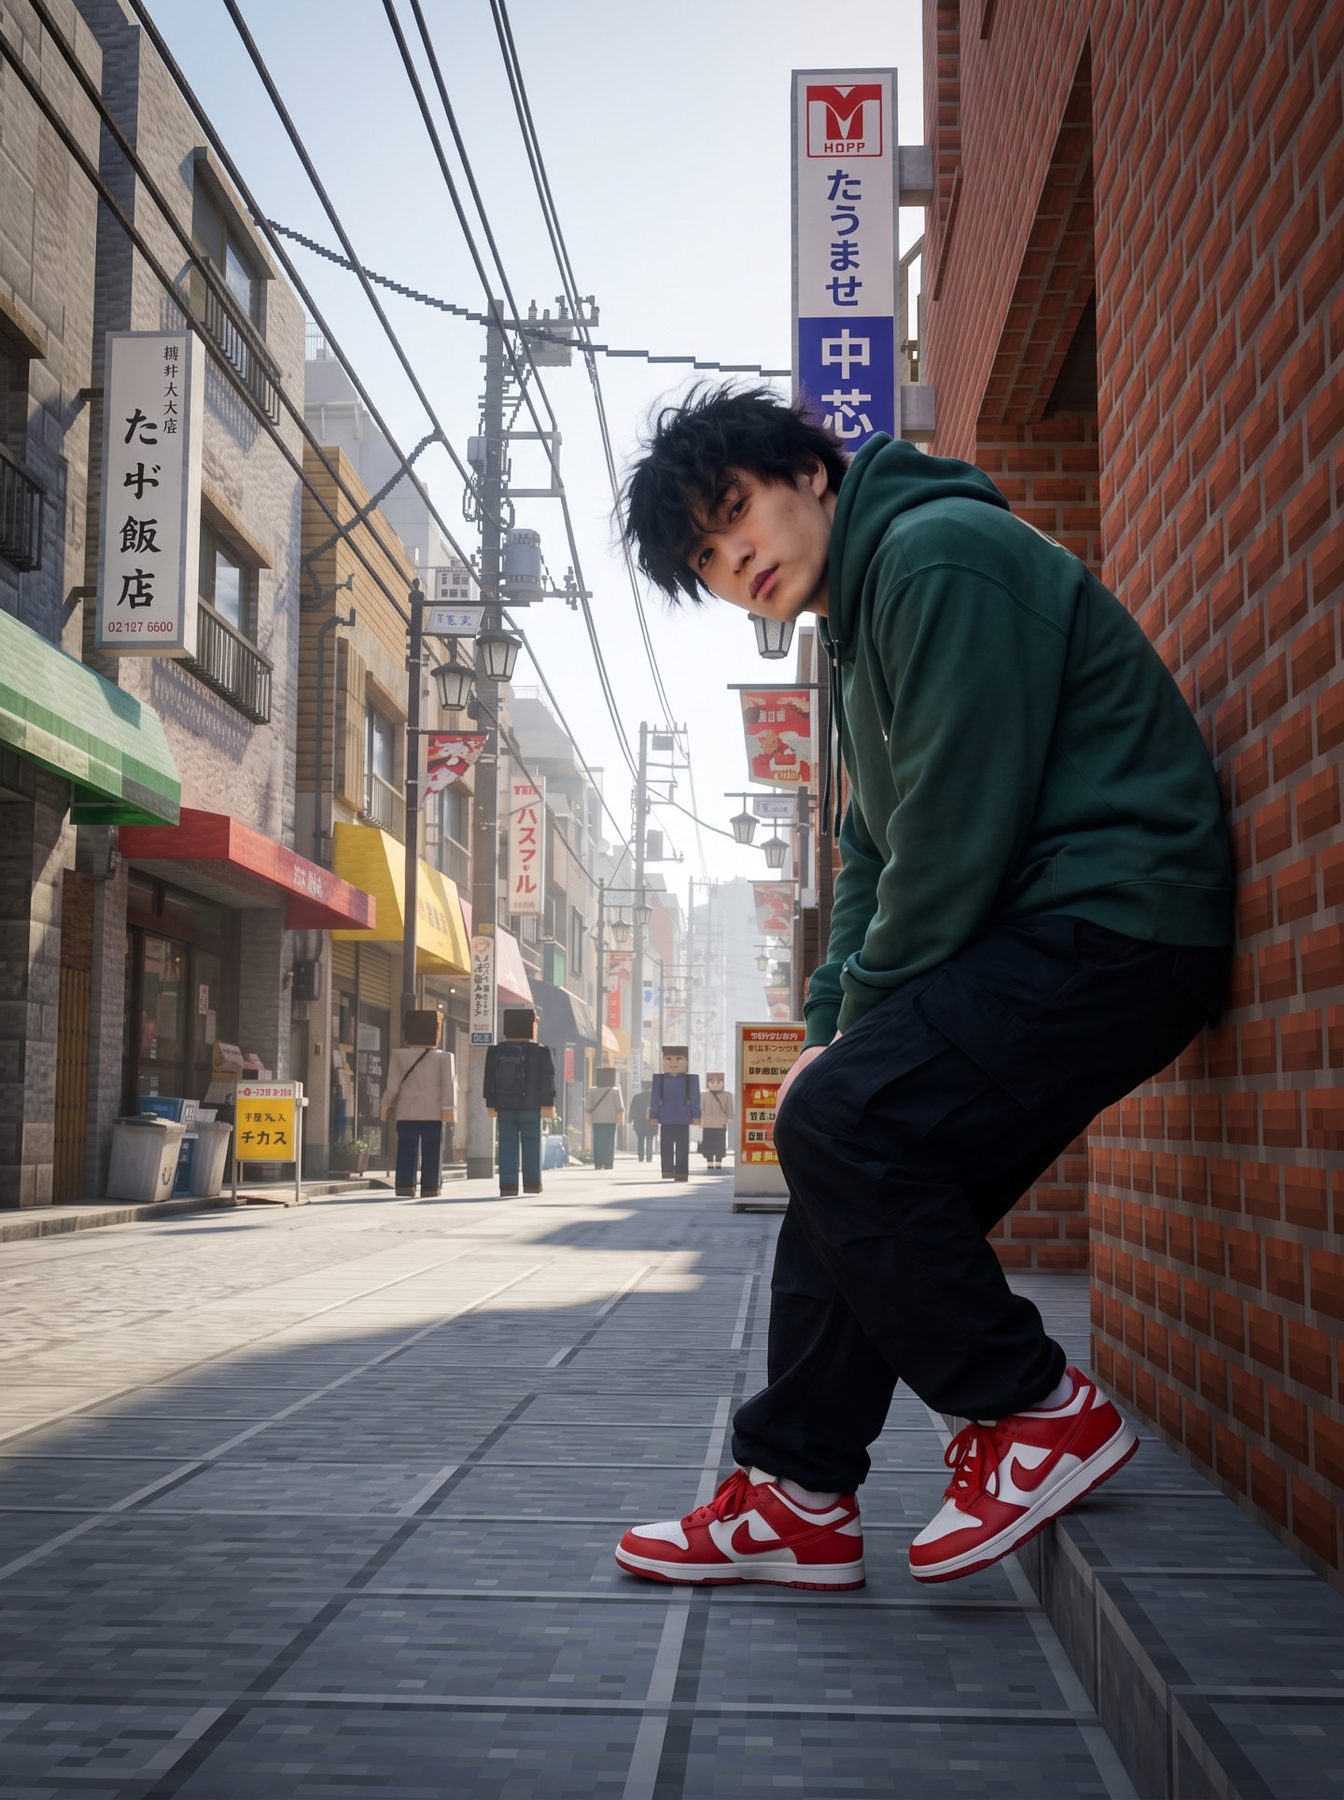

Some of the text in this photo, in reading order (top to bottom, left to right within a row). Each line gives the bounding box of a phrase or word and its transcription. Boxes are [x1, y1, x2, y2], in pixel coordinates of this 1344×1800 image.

[824, 141, 866, 153] HOPP
[825, 168, 863, 307] たうませ
[108, 621, 174, 633] 02 127 6600
[240, 1130, 287, 1145] チカス
